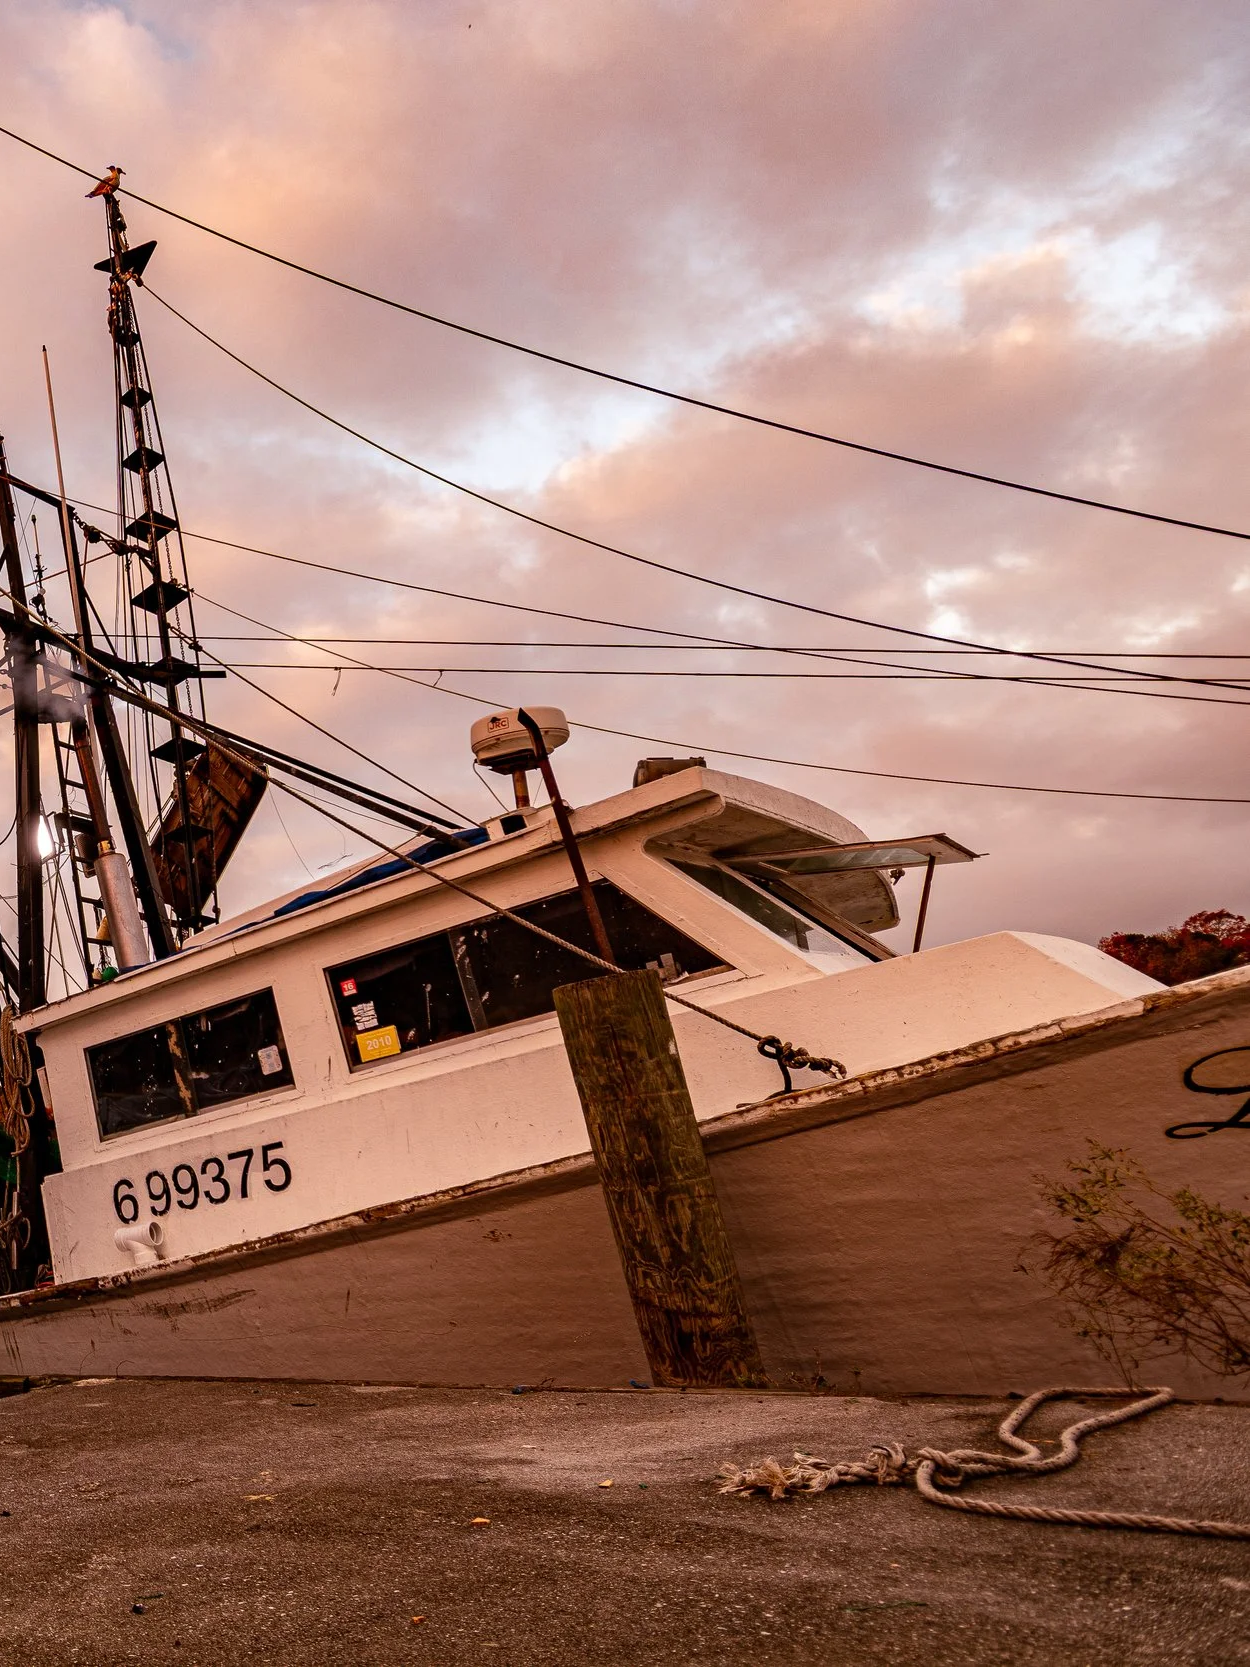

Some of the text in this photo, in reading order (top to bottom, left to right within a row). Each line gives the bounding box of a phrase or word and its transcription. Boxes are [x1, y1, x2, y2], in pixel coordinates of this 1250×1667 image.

[489, 720, 508, 730] JRC
[342, 982, 354, 991] 16
[366, 1035, 392, 1051] 2010
[113, 1141, 292, 1224] 699375
